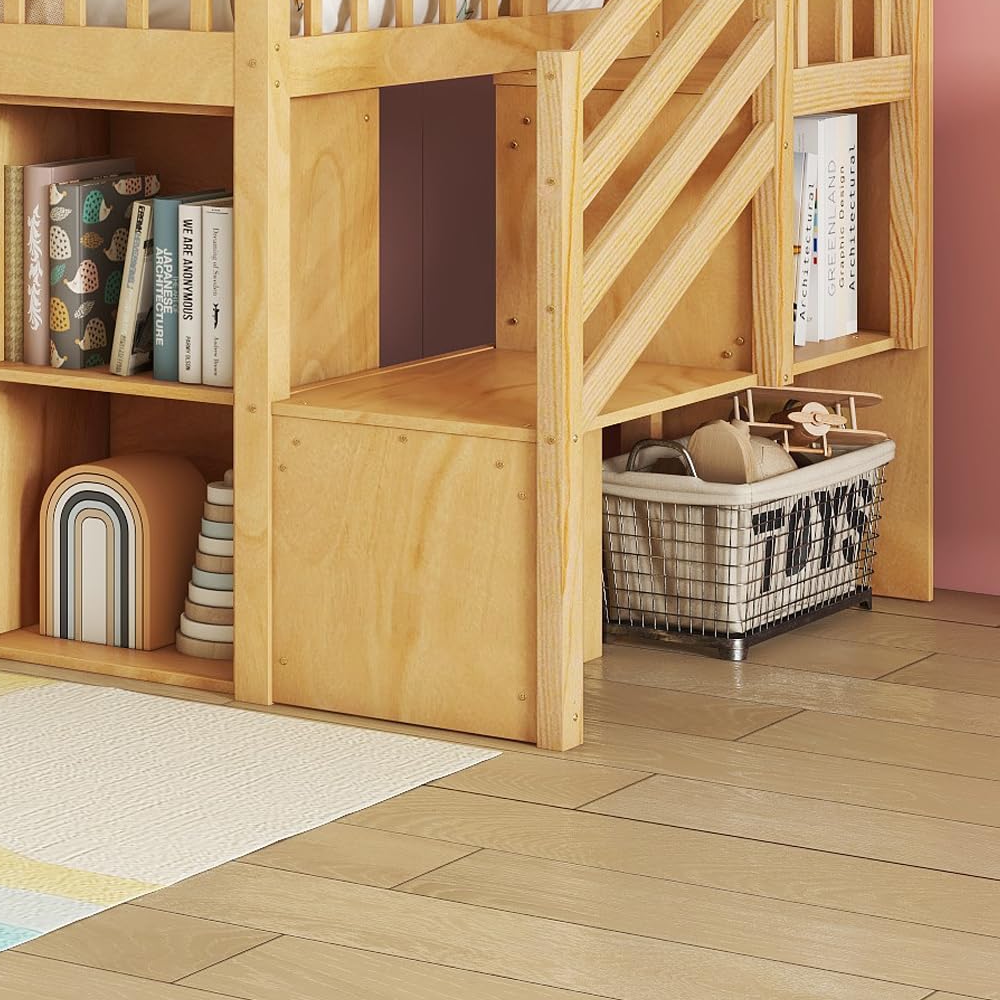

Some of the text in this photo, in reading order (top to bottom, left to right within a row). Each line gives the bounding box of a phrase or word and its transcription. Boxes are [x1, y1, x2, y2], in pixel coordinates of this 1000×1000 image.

[183, 219, 193, 321] WE ARE ANONYMOUS
[211, 228, 219, 260] Dreaming
[799, 183, 815, 321] Architectural
[827, 159, 837, 297] GREENLAND
[155, 247, 164, 346] ARCHITECTURE
[163, 248, 173, 314] JAPANESE
[752, 479, 874, 594] TOYS
